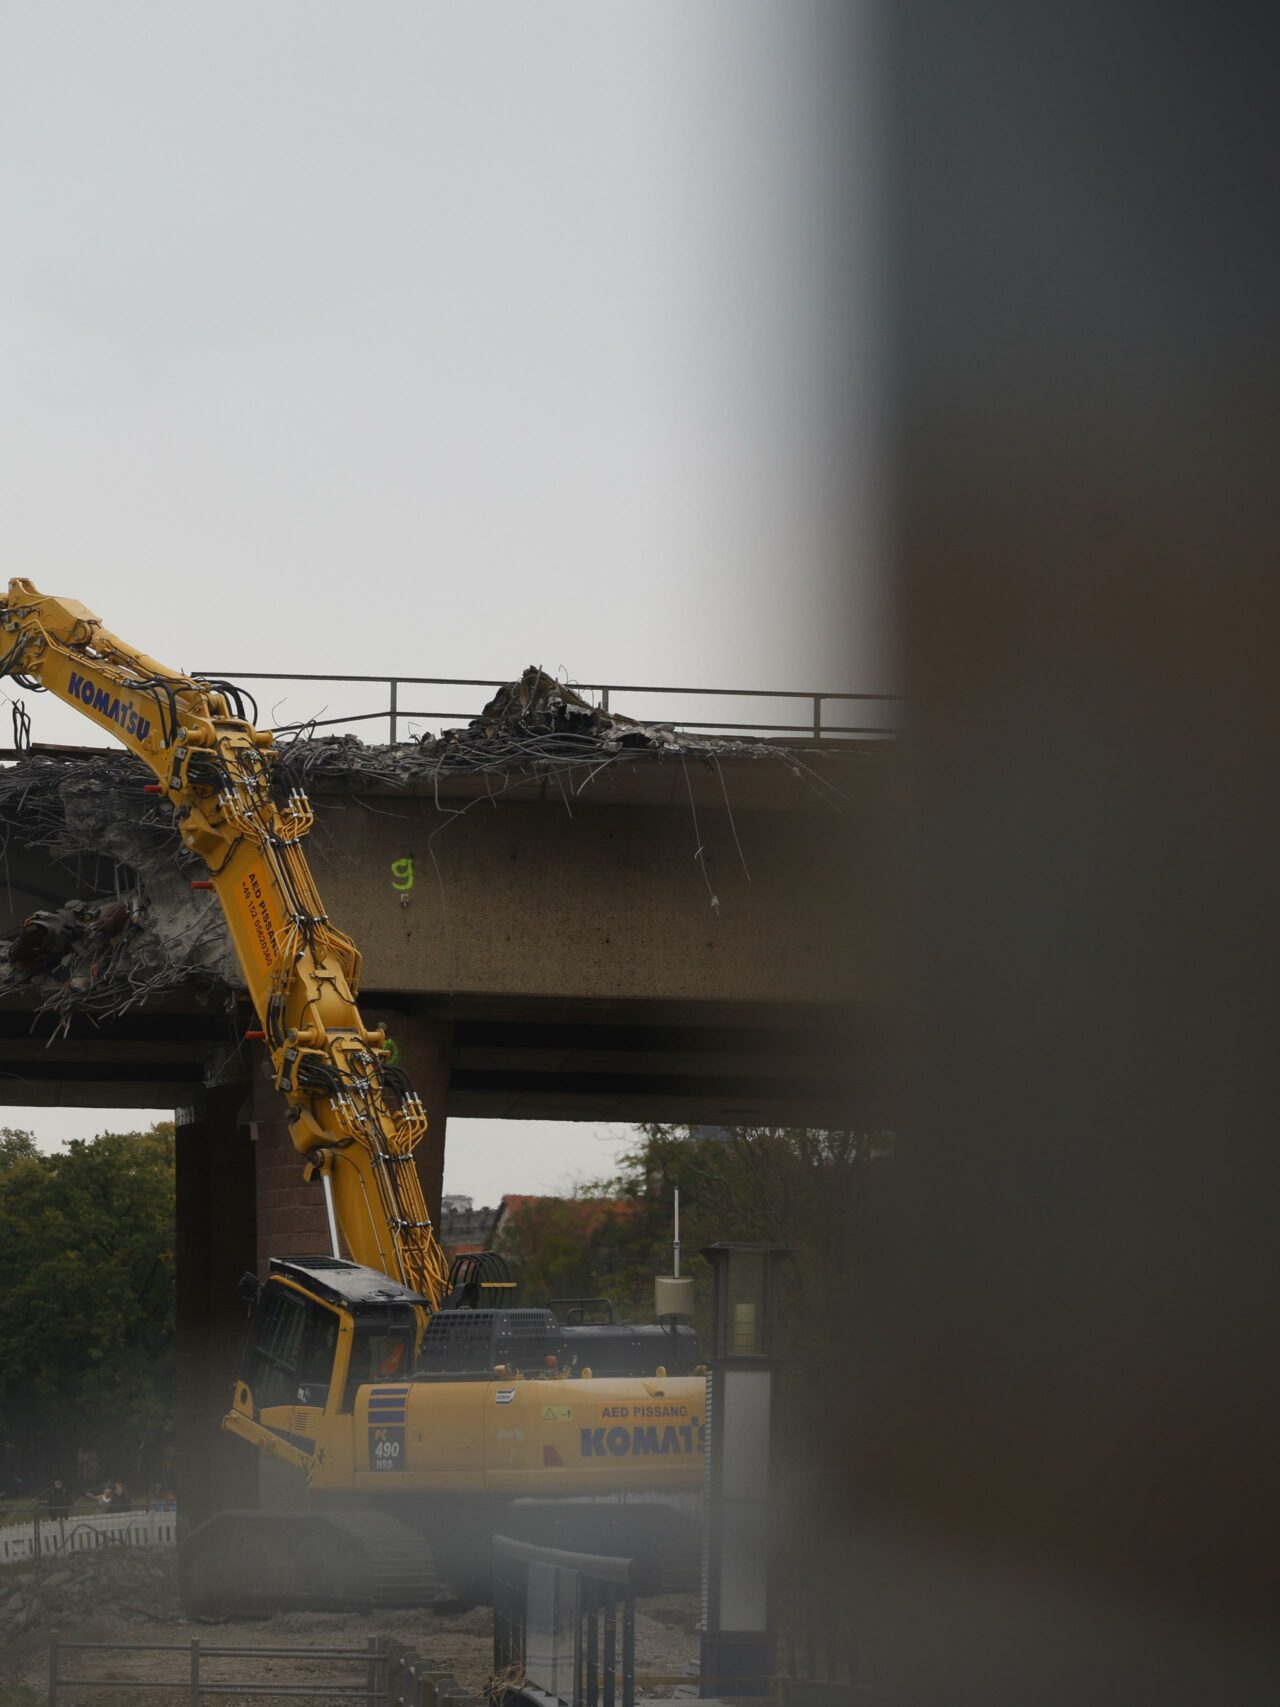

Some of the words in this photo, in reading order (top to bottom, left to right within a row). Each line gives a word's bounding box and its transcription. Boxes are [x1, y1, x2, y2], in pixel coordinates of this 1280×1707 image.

[68, 671, 151, 742] KOMATSU
[249, 873, 262, 899] AED
[242, 881, 251, 900] +49
[248, 901, 258, 919] 152
[602, 1406, 629, 1418] AED
[633, 1405, 688, 1418] PISSANG
[375, 1429, 388, 1441] PC
[375, 1441, 400, 1458] 490
[376, 1459, 394, 1470] HRD
